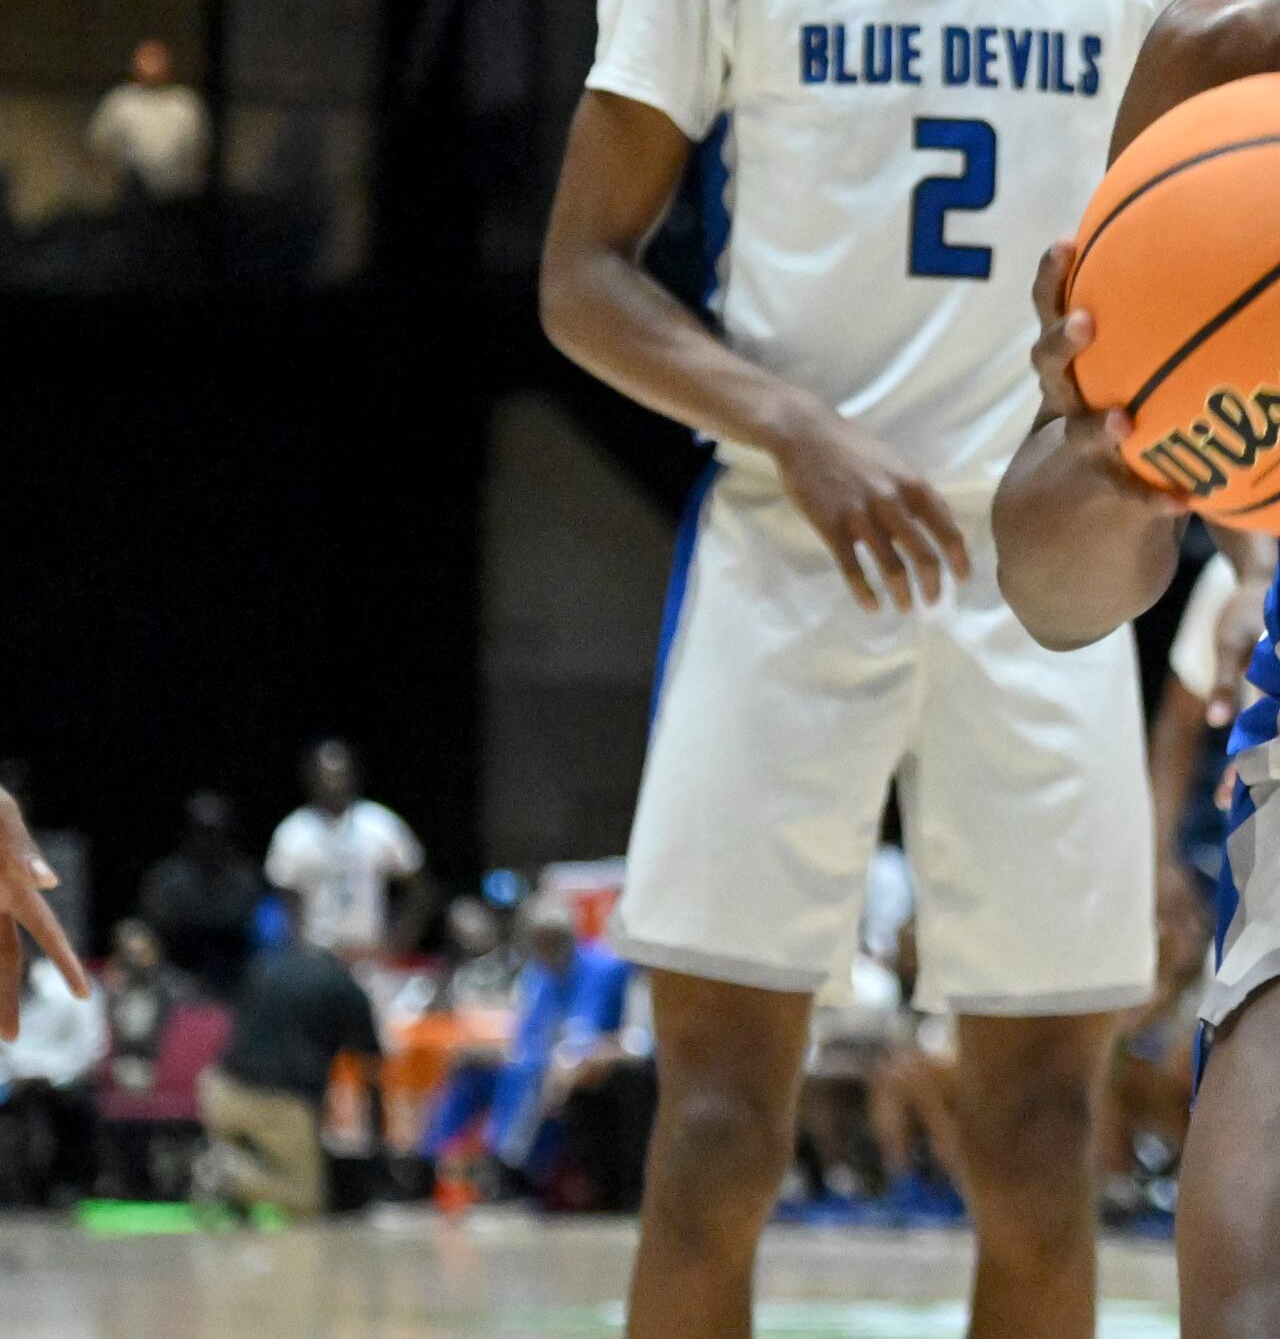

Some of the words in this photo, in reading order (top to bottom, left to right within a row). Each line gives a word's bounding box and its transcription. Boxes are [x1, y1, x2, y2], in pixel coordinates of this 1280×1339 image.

[800, 23, 922, 86] BLUE
[942, 26, 1103, 98] DEVILS
[907, 116, 998, 280] 2
